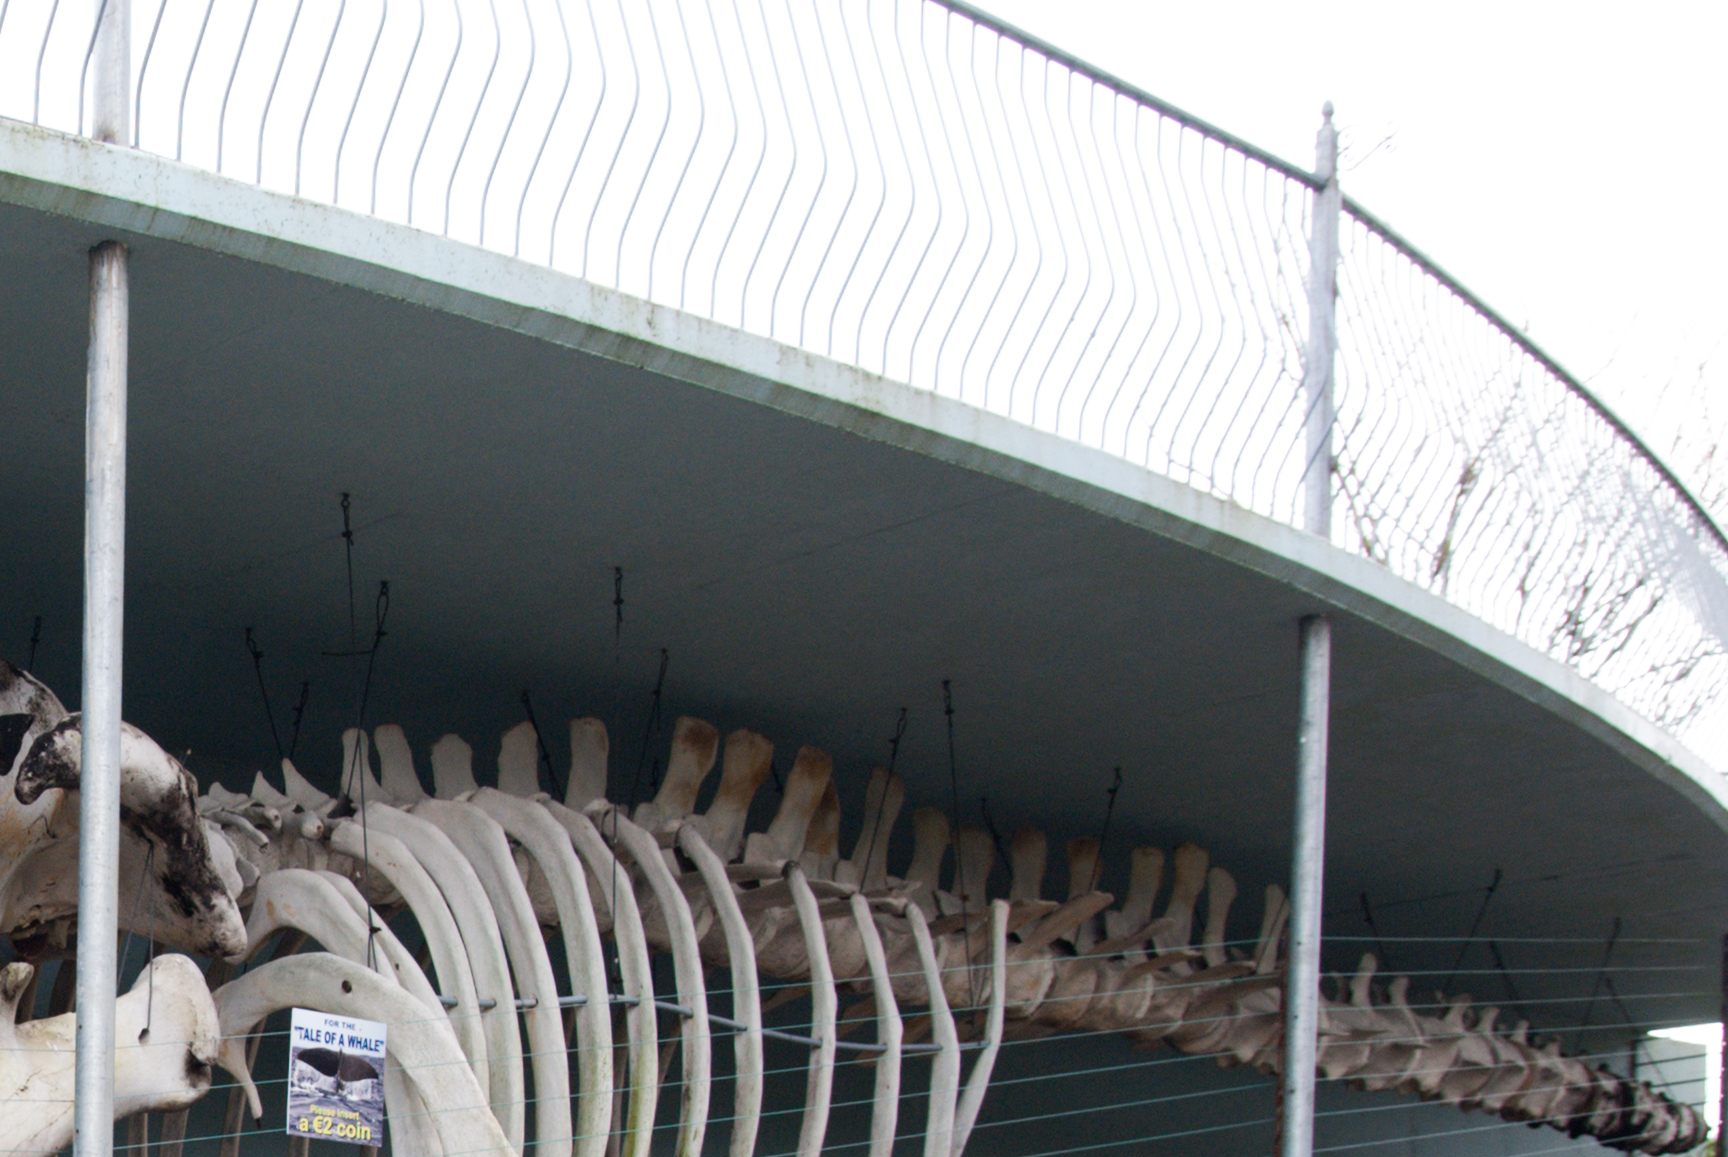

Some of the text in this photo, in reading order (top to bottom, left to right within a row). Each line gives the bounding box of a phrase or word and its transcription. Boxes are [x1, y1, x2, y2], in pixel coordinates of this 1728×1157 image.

[324, 1019, 355, 1030] FOR THE
[324, 1031, 337, 1044] OF
[338, 1034, 345, 1047] A
[299, 1115, 371, 1140] a €2 coin
